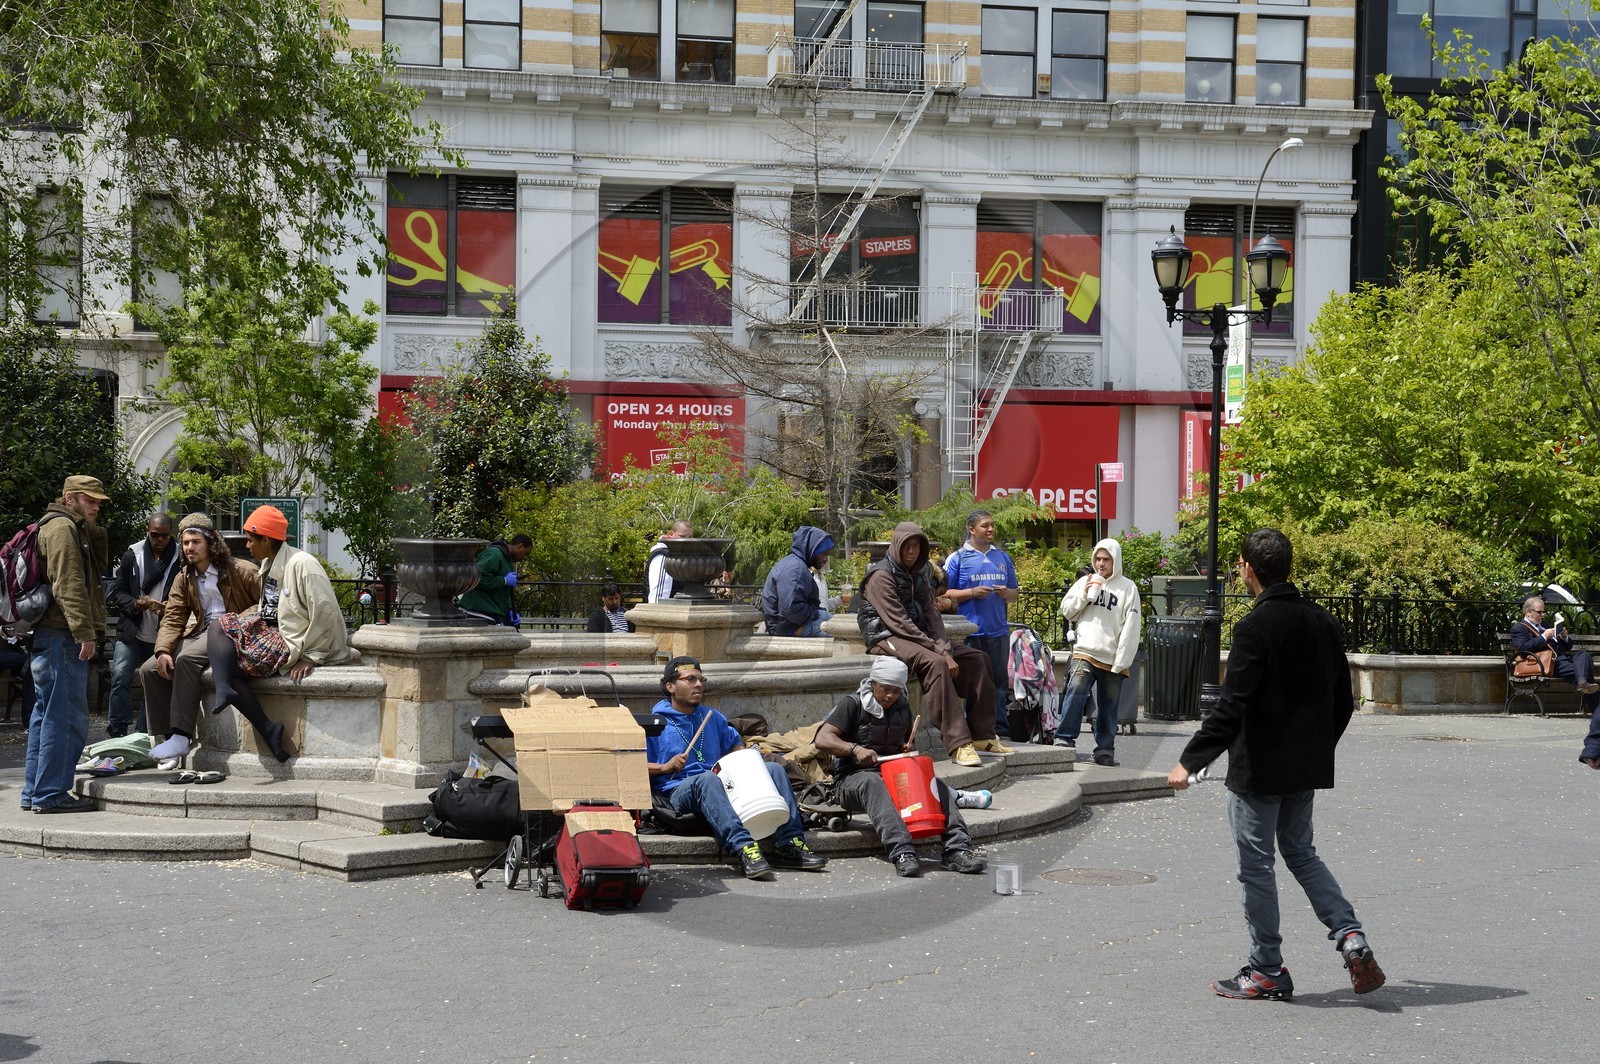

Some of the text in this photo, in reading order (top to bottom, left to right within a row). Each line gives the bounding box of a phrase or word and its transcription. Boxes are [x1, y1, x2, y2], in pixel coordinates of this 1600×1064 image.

[865, 239, 912, 254] STAPLES
[607, 403, 733, 416] OPEN 24 HOURS
[613, 419, 659, 431] Monday
[655, 451, 685, 461] STAES
[1067, 538, 1083, 549] 24
[970, 573, 1006, 582] SAMSUNG
[1087, 589, 1119, 611] AP
